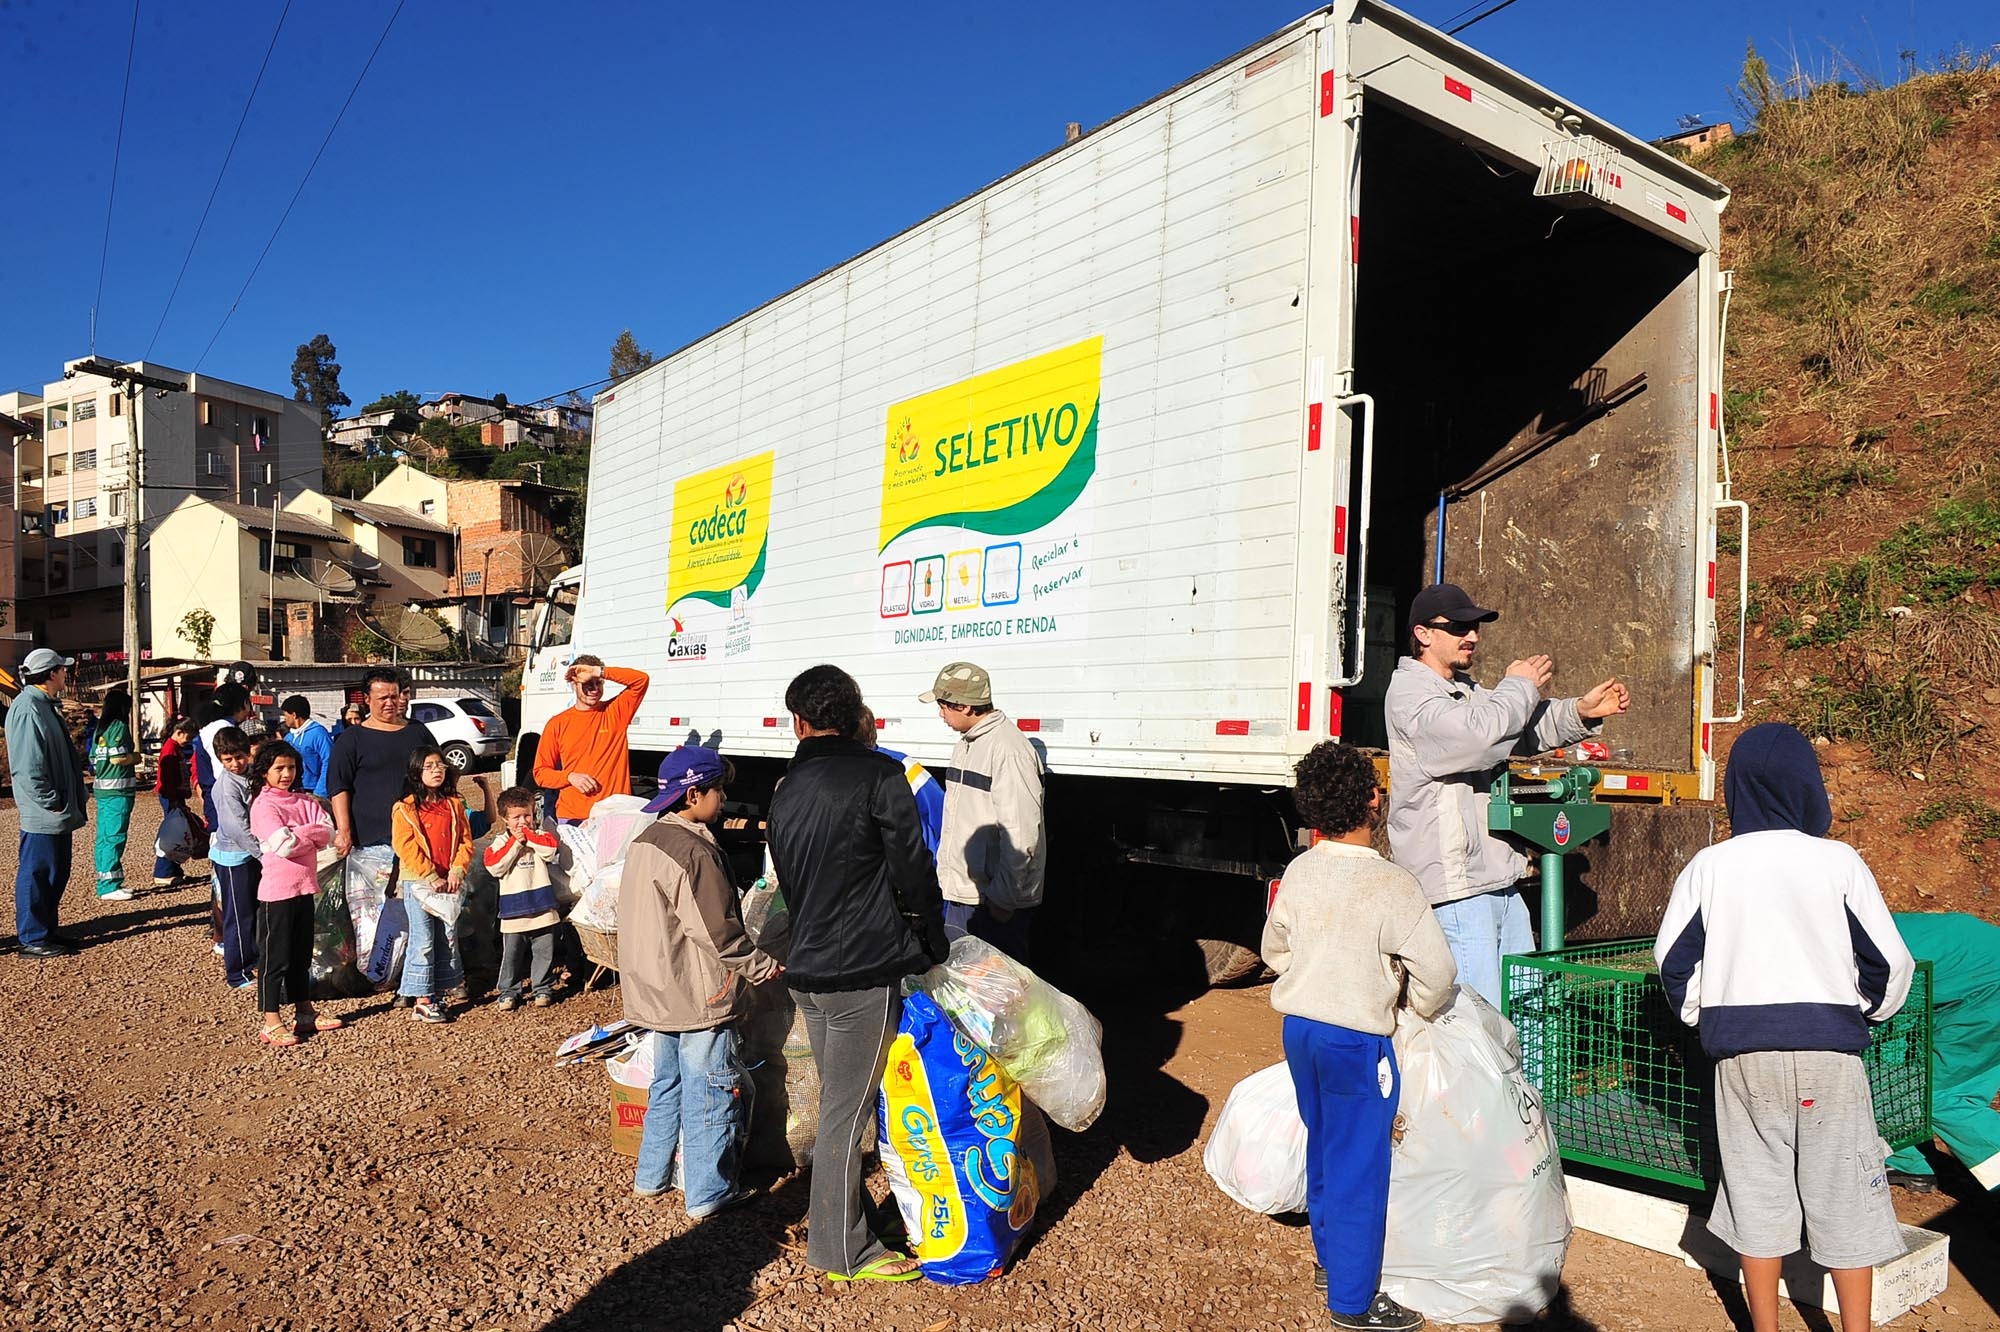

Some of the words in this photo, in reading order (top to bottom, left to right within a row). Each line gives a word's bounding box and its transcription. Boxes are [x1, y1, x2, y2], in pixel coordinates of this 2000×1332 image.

[934, 402, 1078, 477] SELETIVO
[690, 505, 747, 545] codeca
[1031, 543, 1069, 570] Reciclar
[991, 591, 1009, 600] PAPEL
[1033, 566, 1083, 600] Preservar
[919, 600, 935, 608] VIDRO
[953, 596, 971, 604] METAL
[895, 626, 948, 644] DIGNIDADE,
[951, 620, 1001, 640] EMPREGO
[1006, 619, 1012, 635] E
[1017, 616, 1057, 634] RENDA
[668, 638, 706, 657] Caxias
[374, 934, 394, 976] Nordeste
[1532, 1154, 1552, 1179] APOIO
